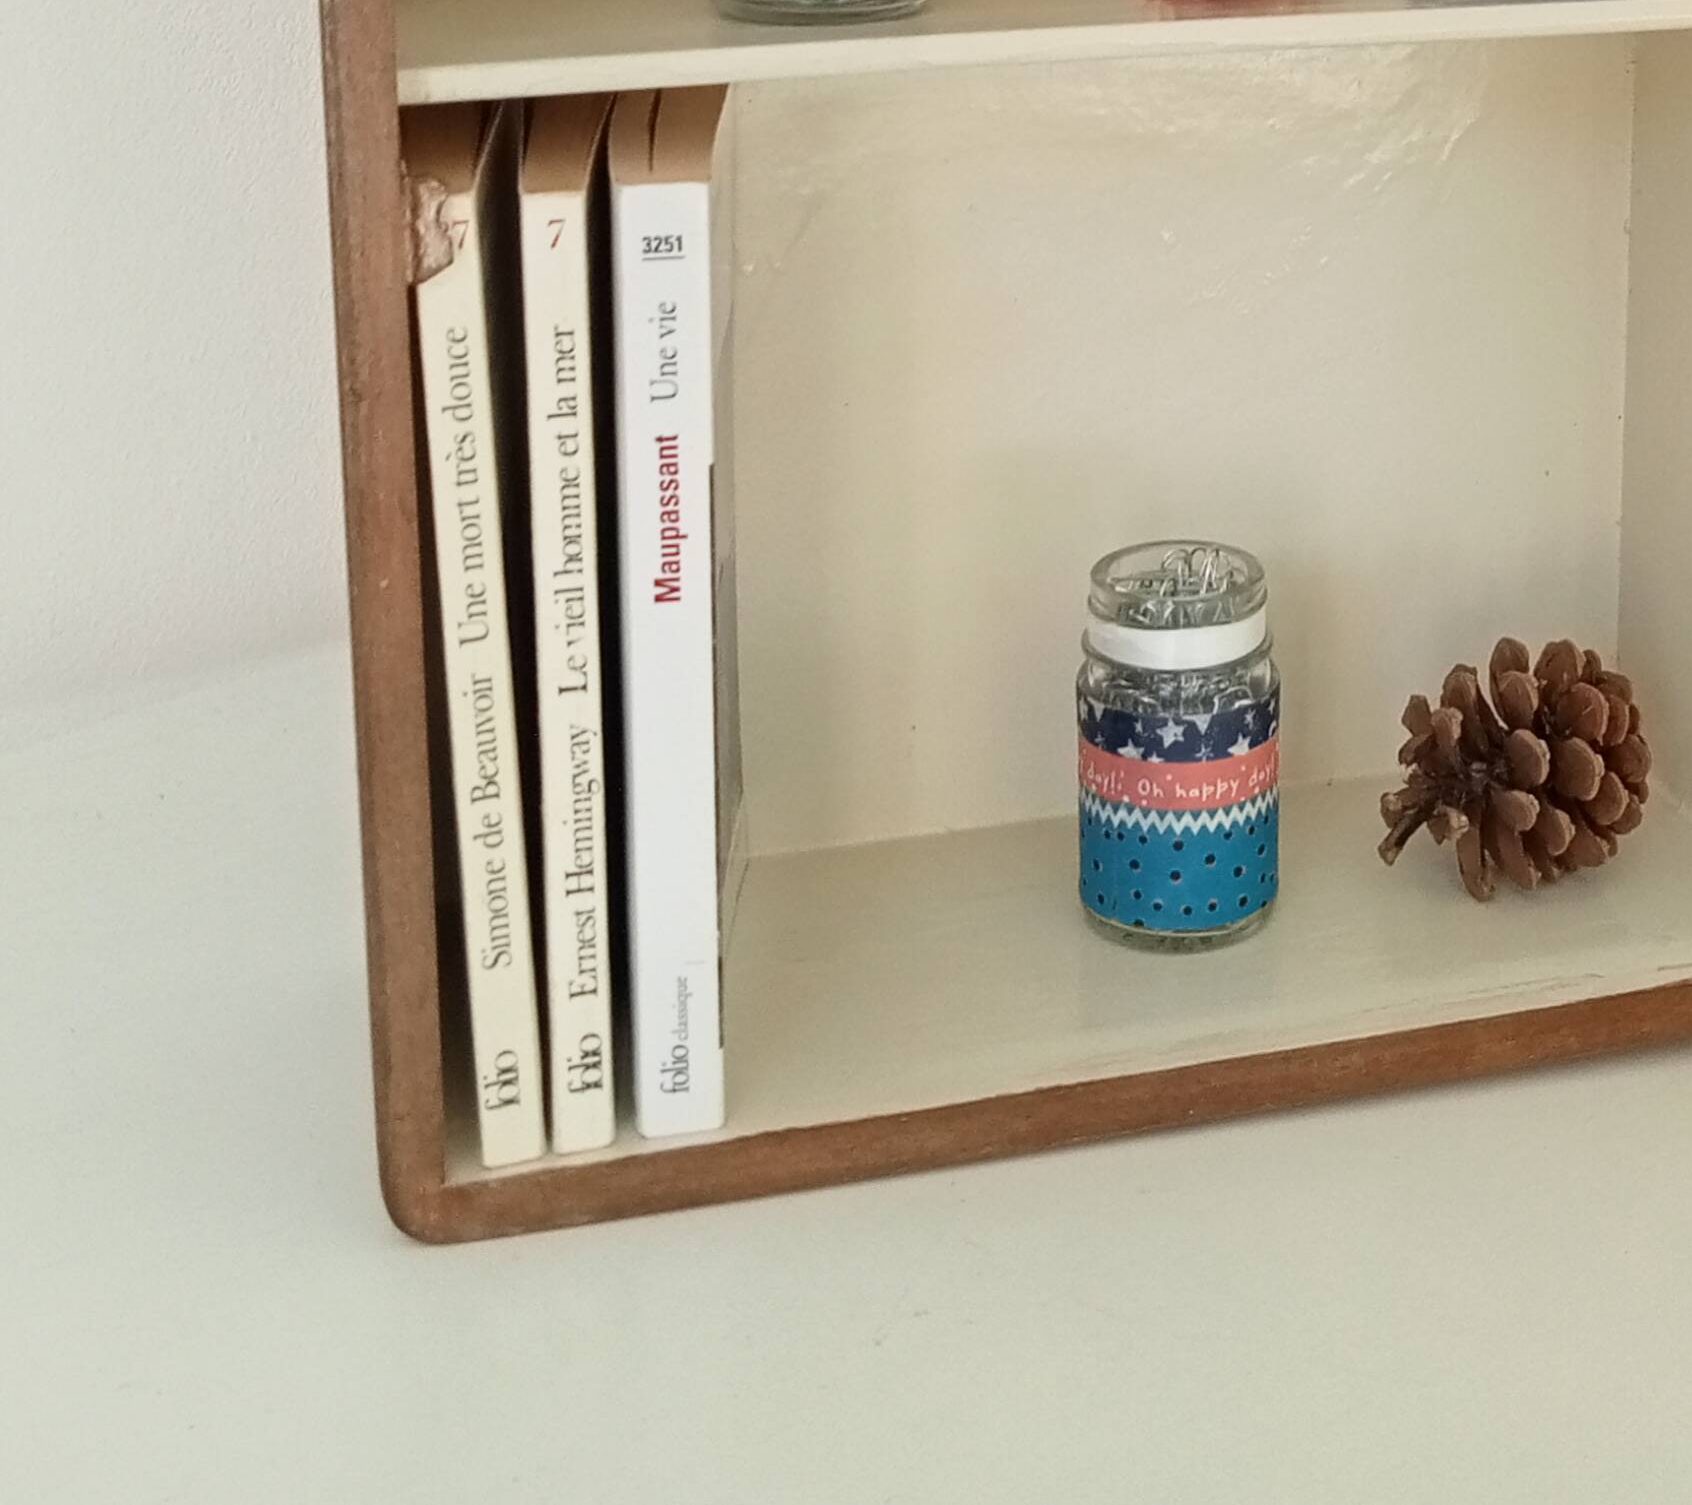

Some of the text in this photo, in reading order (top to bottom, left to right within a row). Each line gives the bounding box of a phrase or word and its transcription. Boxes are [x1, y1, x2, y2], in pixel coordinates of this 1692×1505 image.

[547, 218, 566, 249] 7
[641, 235, 685, 255] 3251
[648, 300, 688, 605] Maupassant Une vie
[441, 325, 512, 971] Simone de Beauvoir Une mort très douce
[546, 323, 601, 1001] Ernest Hemingway Le vieil homme et la mer
[1137, 778, 1164, 798] Oh
[1174, 777, 1240, 802] happy
[566, 1032, 604, 1096] folio
[660, 976, 694, 1095] folio classique
[482, 1048, 521, 1112] folio
